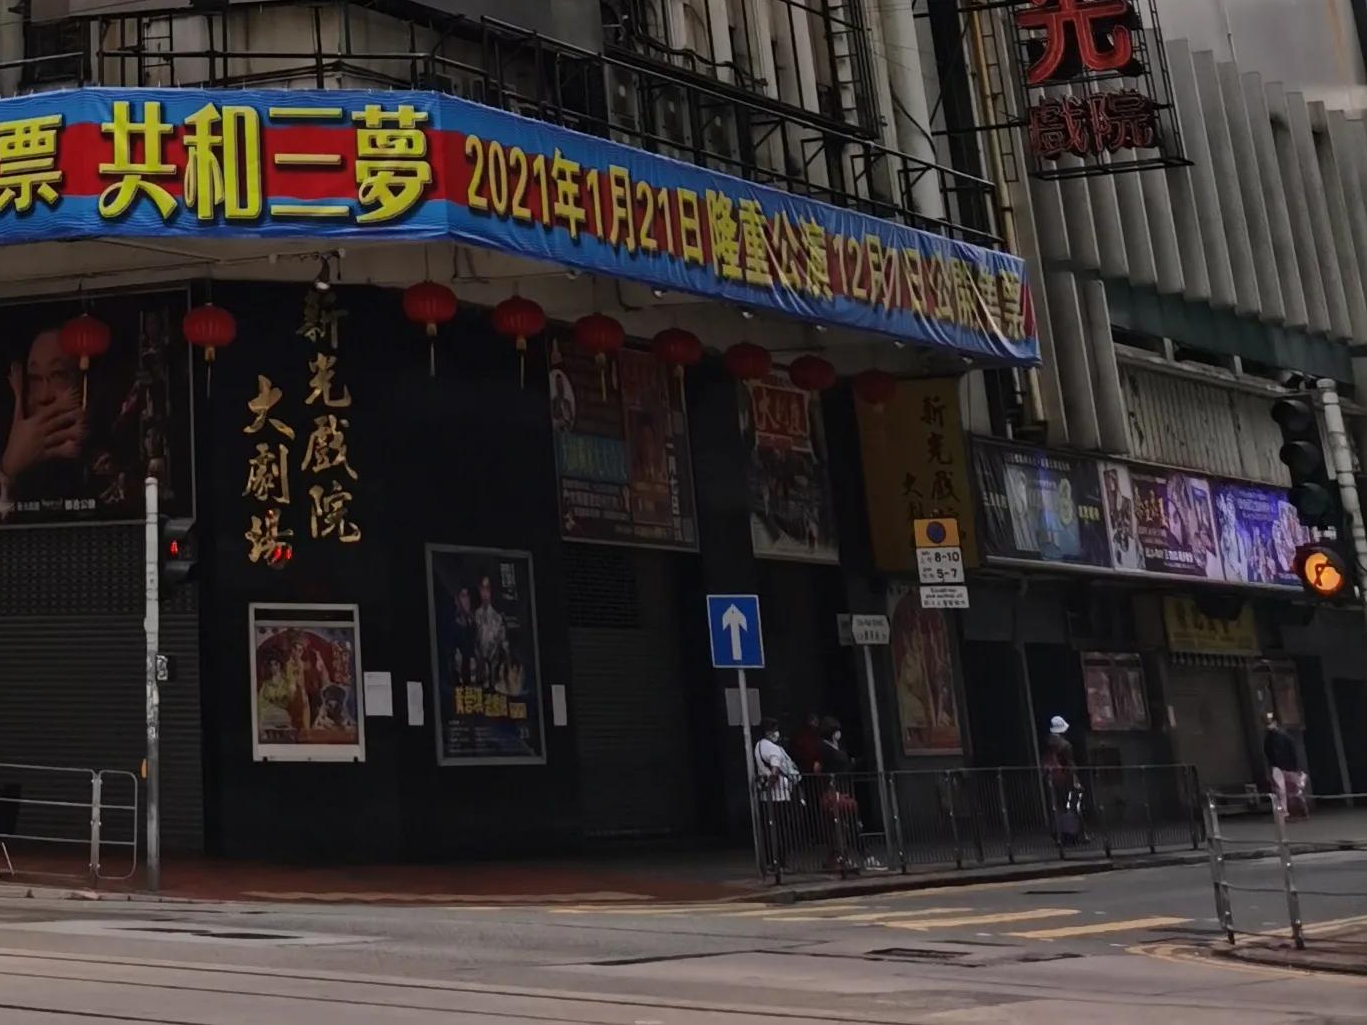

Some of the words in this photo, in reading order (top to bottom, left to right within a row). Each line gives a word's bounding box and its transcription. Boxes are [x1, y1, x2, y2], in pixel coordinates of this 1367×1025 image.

[98, 101, 432, 224] 共和三夢
[1028, 88, 1157, 161] 戲院
[241, 374, 296, 567] 大劇場
[296, 286, 362, 543] 新光戲院
[920, 394, 961, 519] 新光戲
[934, 551, 960, 563] 8-10
[936, 567, 958, 579] 5-7
